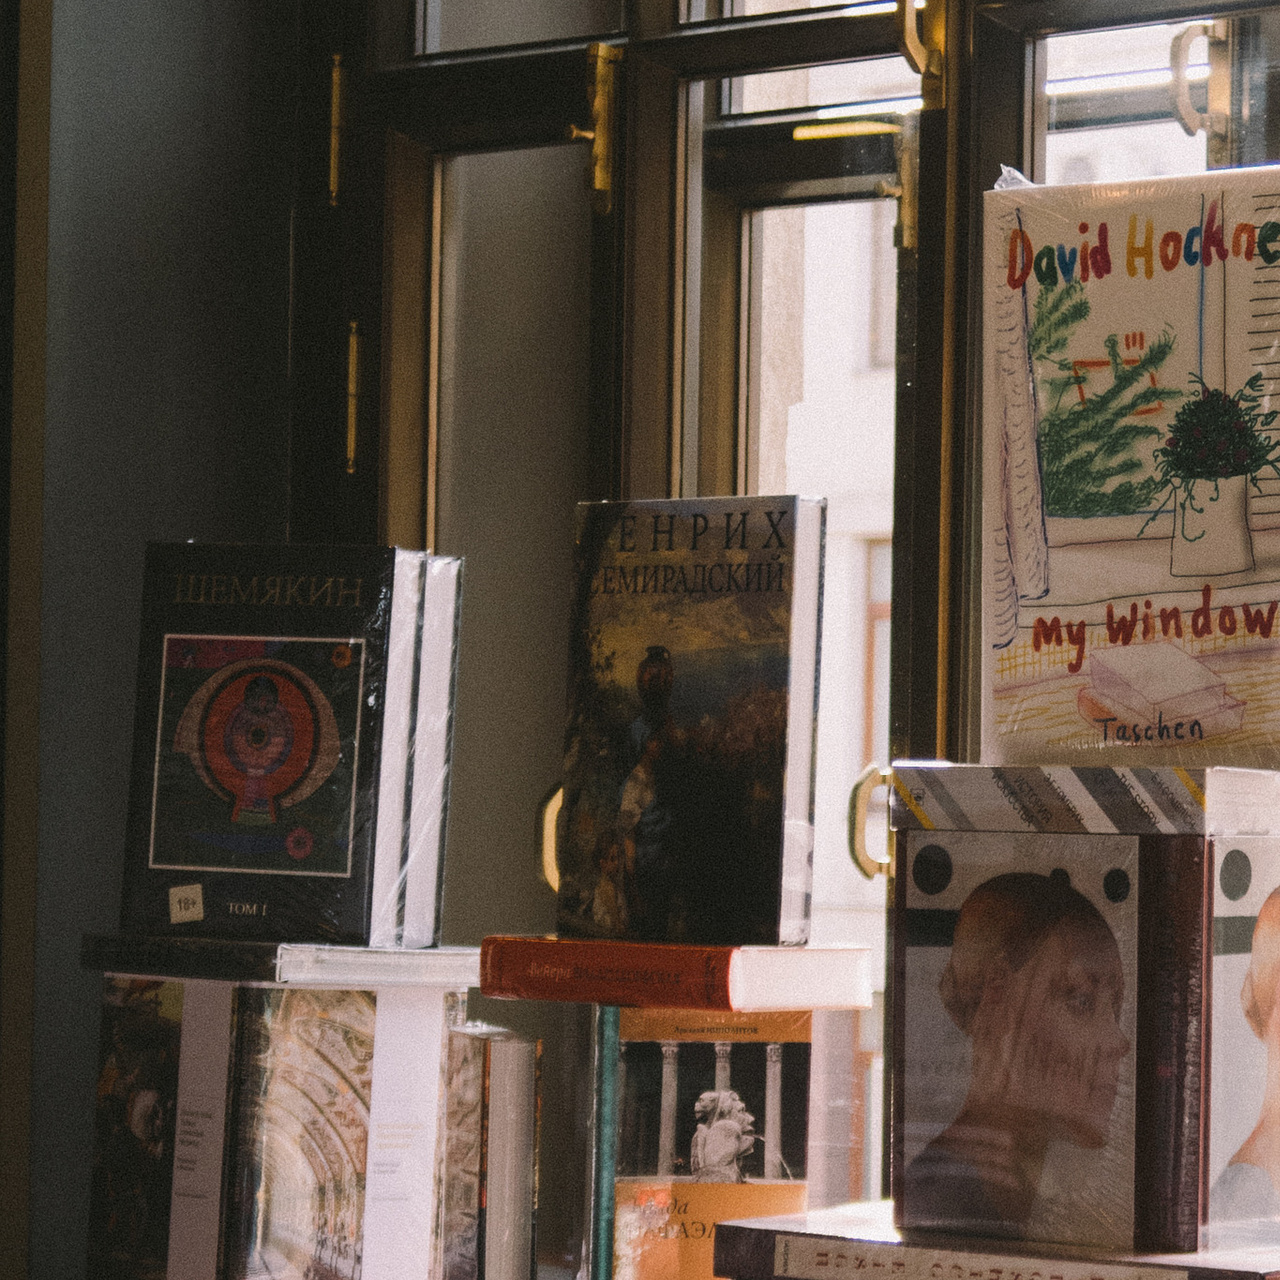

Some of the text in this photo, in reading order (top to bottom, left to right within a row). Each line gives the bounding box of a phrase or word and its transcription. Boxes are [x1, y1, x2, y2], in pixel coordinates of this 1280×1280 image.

[1007, 220, 1111, 290] David
[619, 510, 788, 553] ЕНРИХ
[173, 574, 363, 607] ШЕМЯКИН
[1033, 584, 1279, 674] My Window
[1093, 711, 1205, 744] Taschen
[989, 769, 1039, 828] ИСКУССТВА
[1012, 774, 1055, 825] ИСТОРИЯ
[1115, 773, 1161, 829] THE STORY
[227, 902, 257, 916] ТОМ
